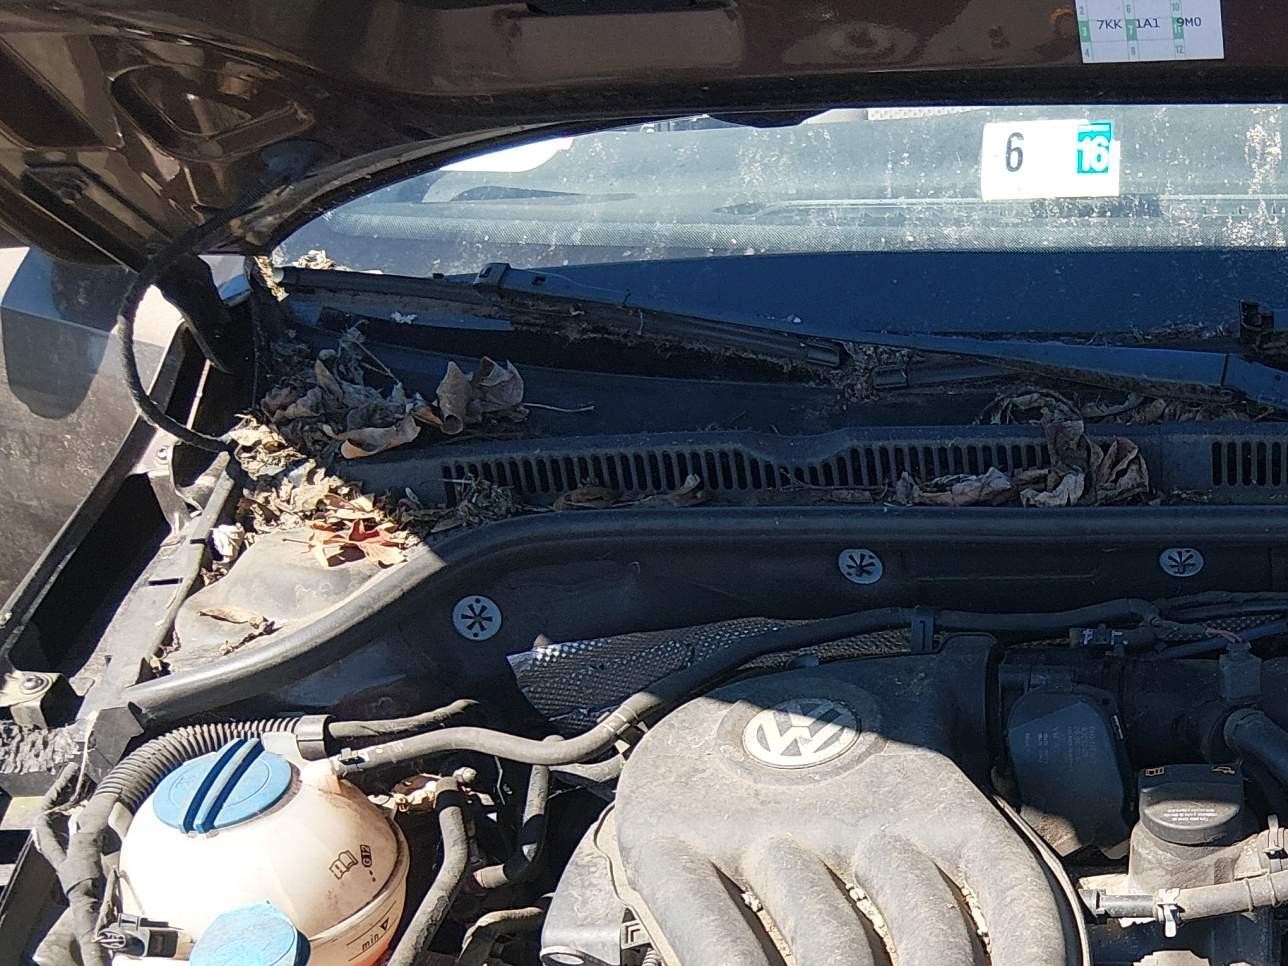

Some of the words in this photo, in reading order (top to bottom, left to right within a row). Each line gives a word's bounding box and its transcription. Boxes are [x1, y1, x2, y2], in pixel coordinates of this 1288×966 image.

[1096, 19, 1123, 30] 7KK
[1135, 17, 1161, 29] 1A1
[1005, 131, 1025, 173] 6
[1077, 134, 1109, 172] 16
[360, 844, 372, 868] G12
[362, 933, 379, 952] min
